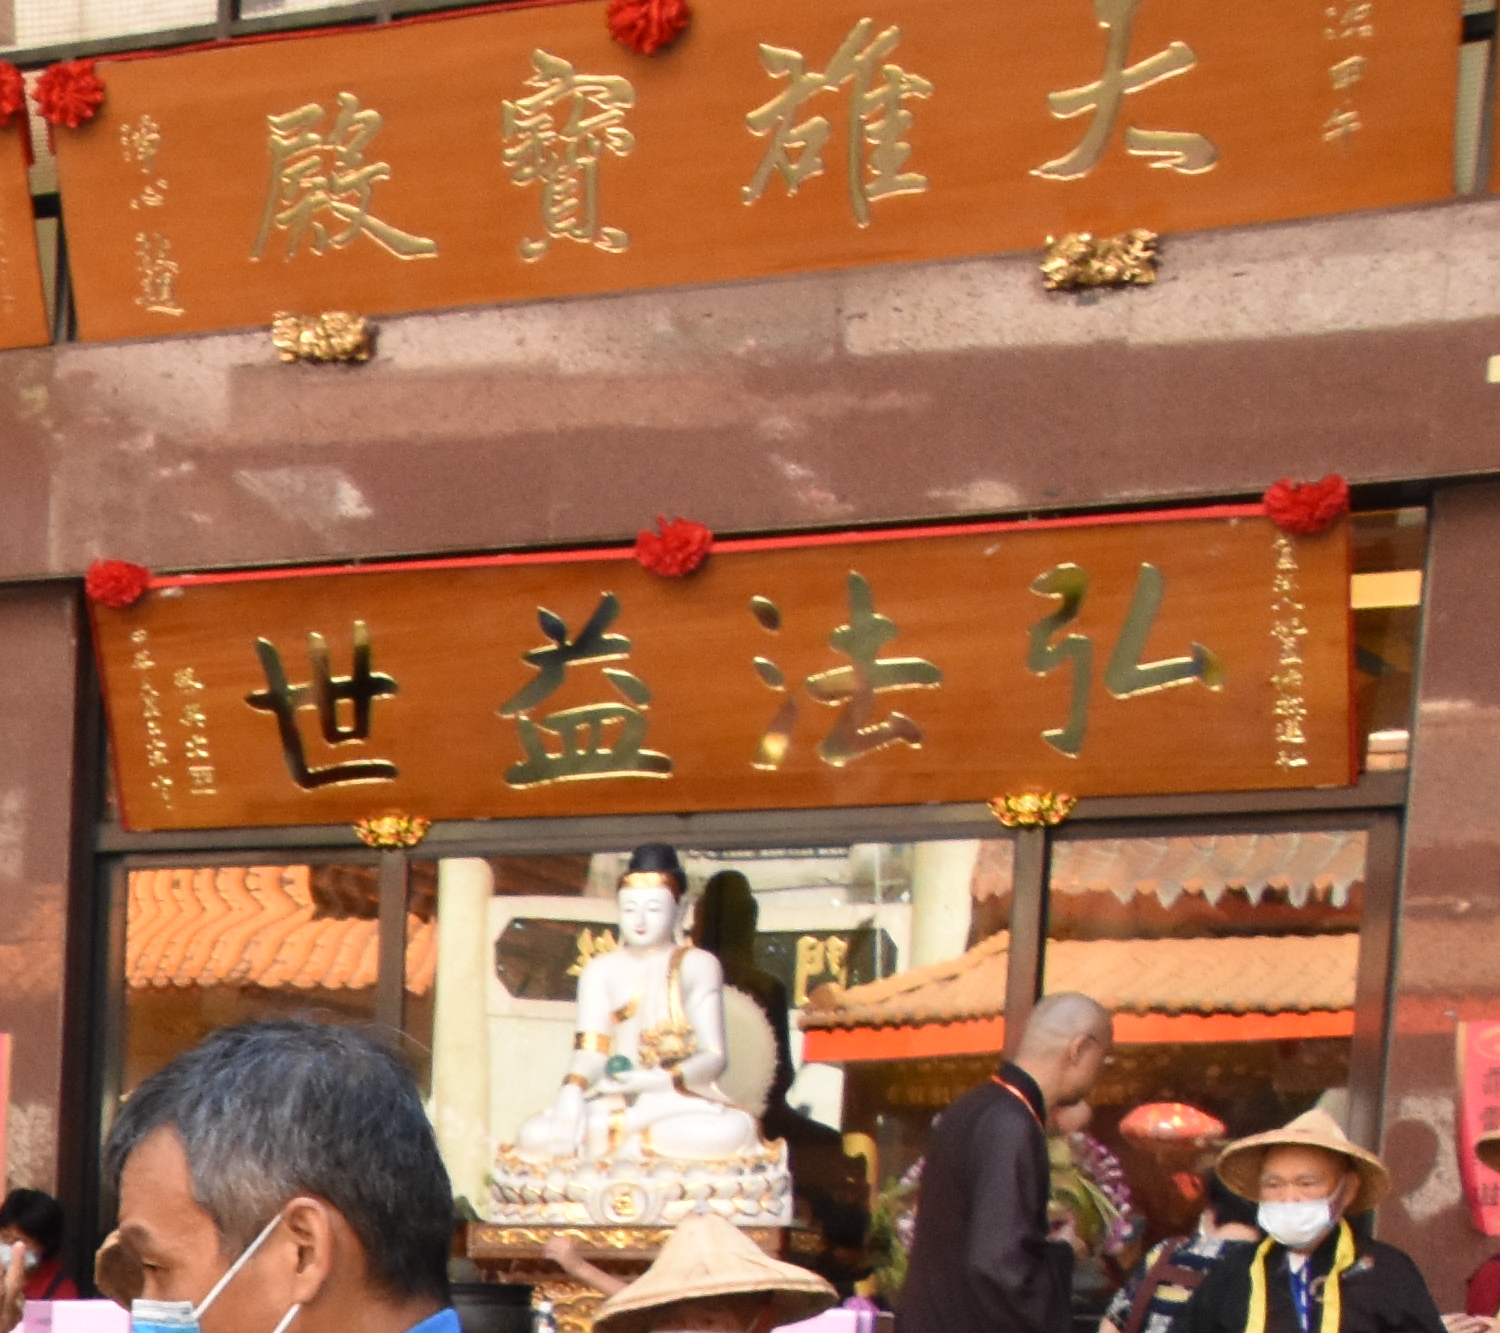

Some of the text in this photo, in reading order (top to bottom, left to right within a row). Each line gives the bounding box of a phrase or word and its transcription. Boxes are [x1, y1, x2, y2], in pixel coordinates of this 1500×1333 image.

[252, 0, 1220, 262] 大雄寶殿
[245, 562, 1222, 790] 弘法益世
